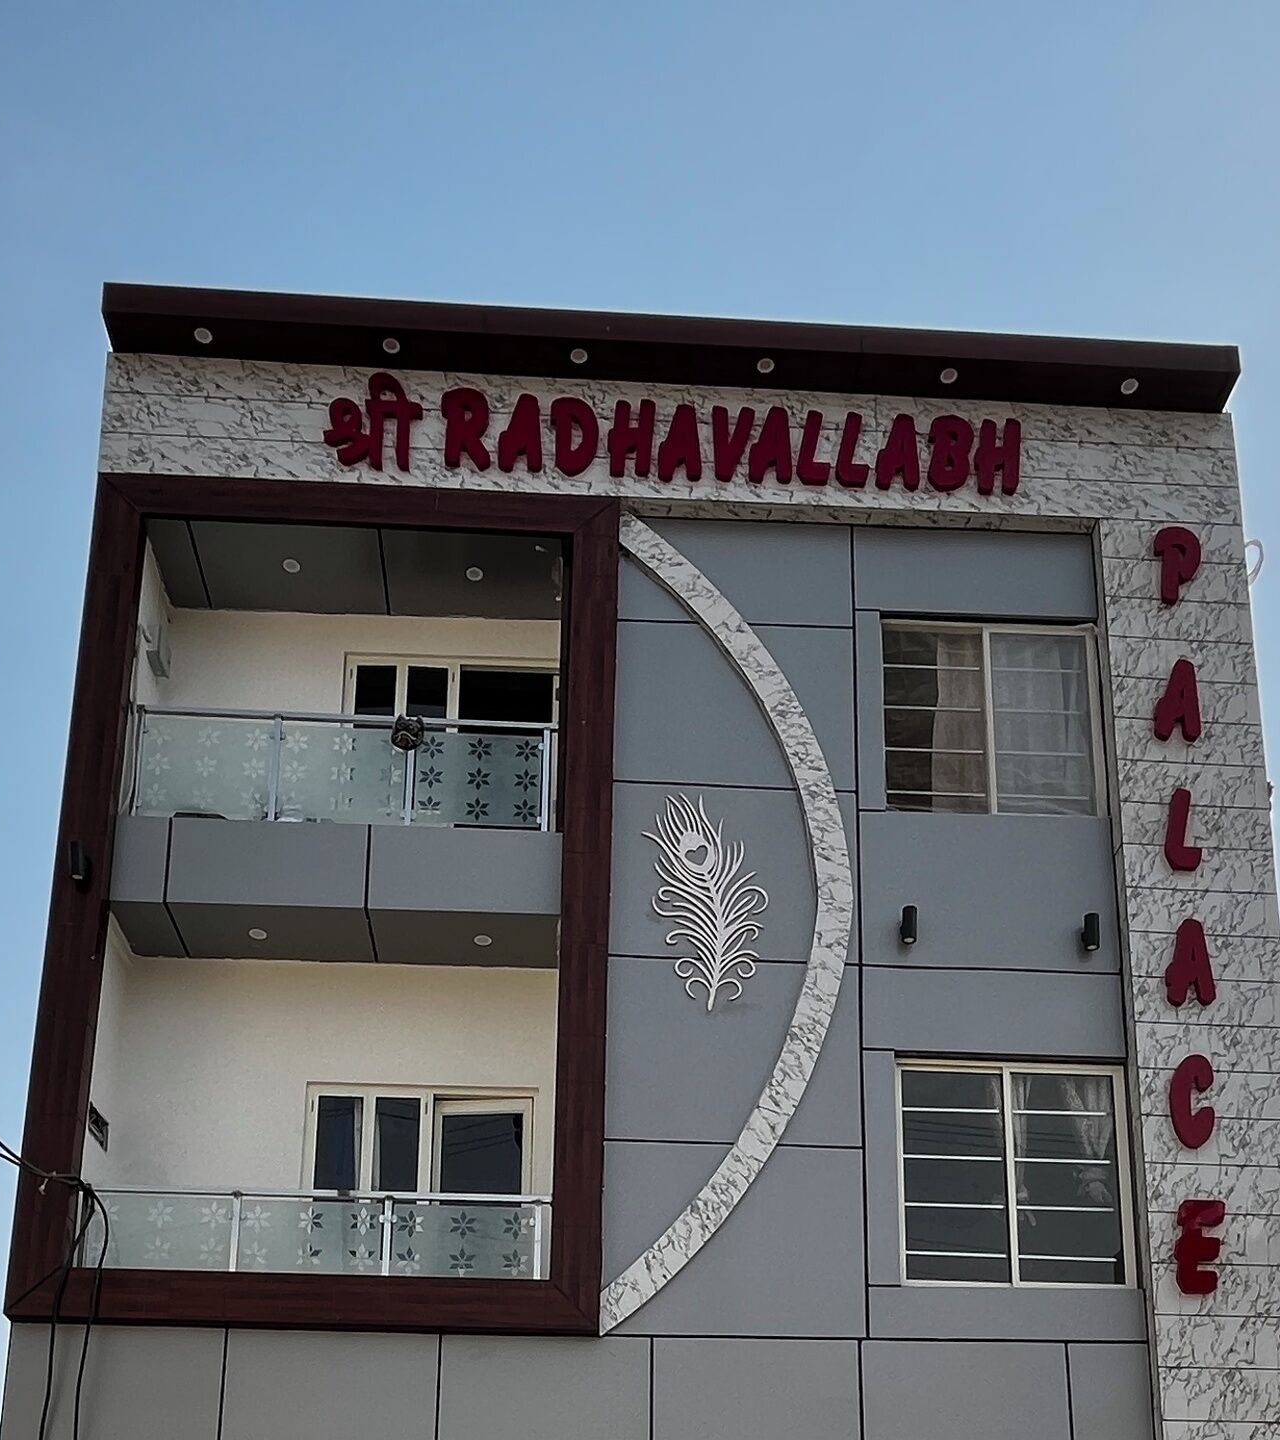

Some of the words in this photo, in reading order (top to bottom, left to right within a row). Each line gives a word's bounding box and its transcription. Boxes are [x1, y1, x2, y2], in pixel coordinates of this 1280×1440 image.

[323, 373, 422, 472] श्री
[441, 387, 1022, 495] RADHAVALLABH
[1153, 526, 1227, 1295] PALACE
